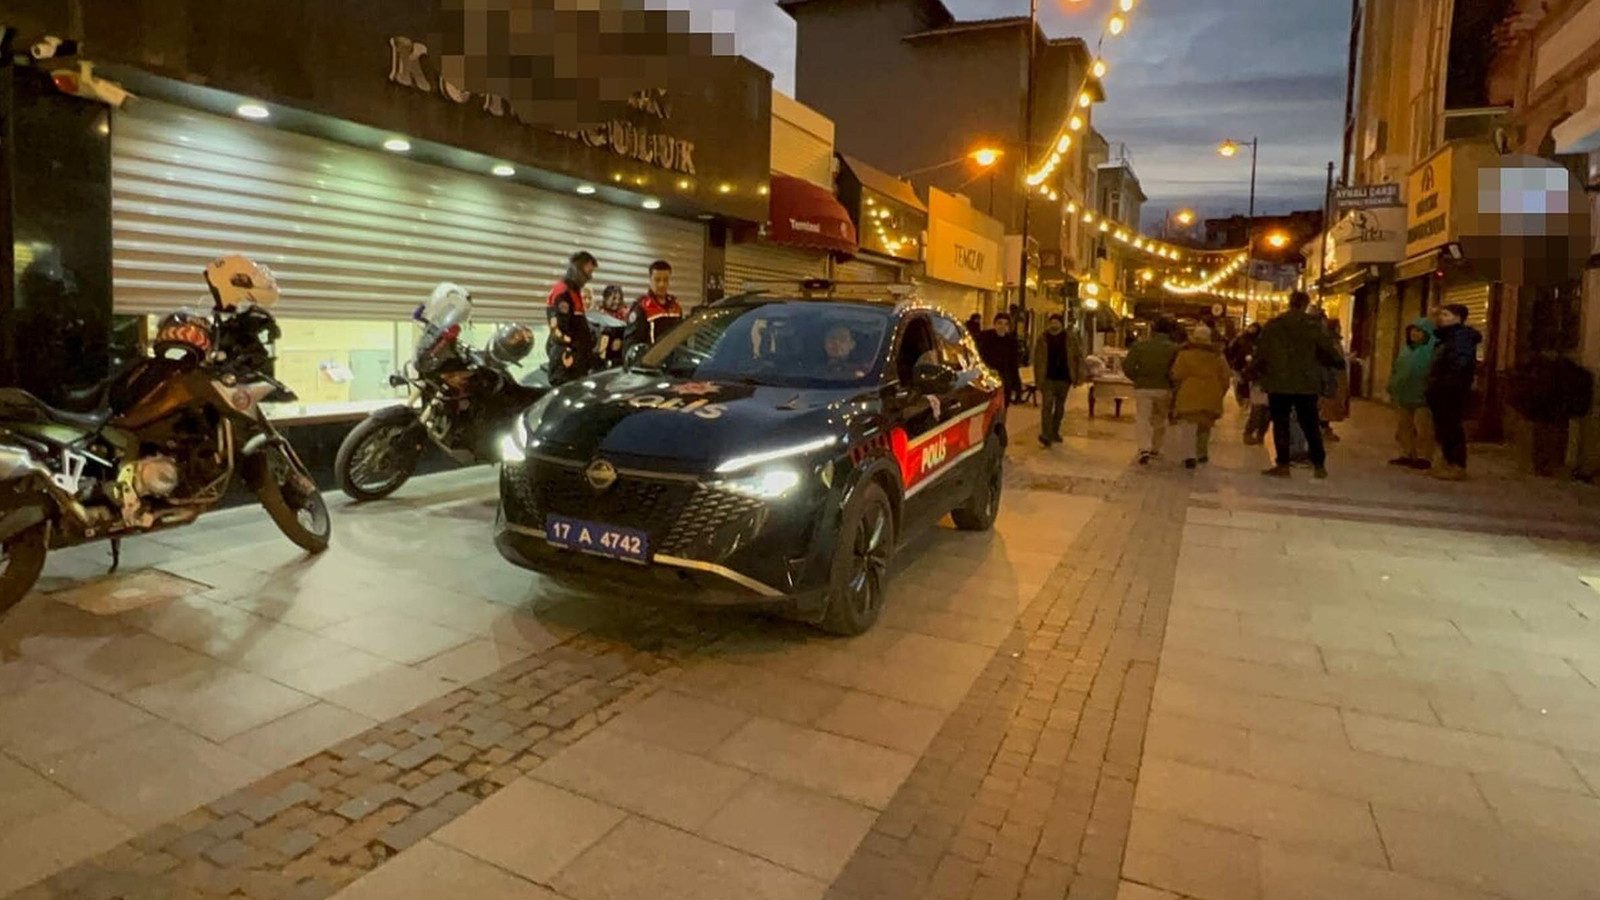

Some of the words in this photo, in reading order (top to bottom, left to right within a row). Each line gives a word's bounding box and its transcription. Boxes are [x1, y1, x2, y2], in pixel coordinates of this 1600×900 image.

[553, 522, 571, 539] 17
[579, 527, 592, 545] A
[600, 531, 641, 554] 4742
